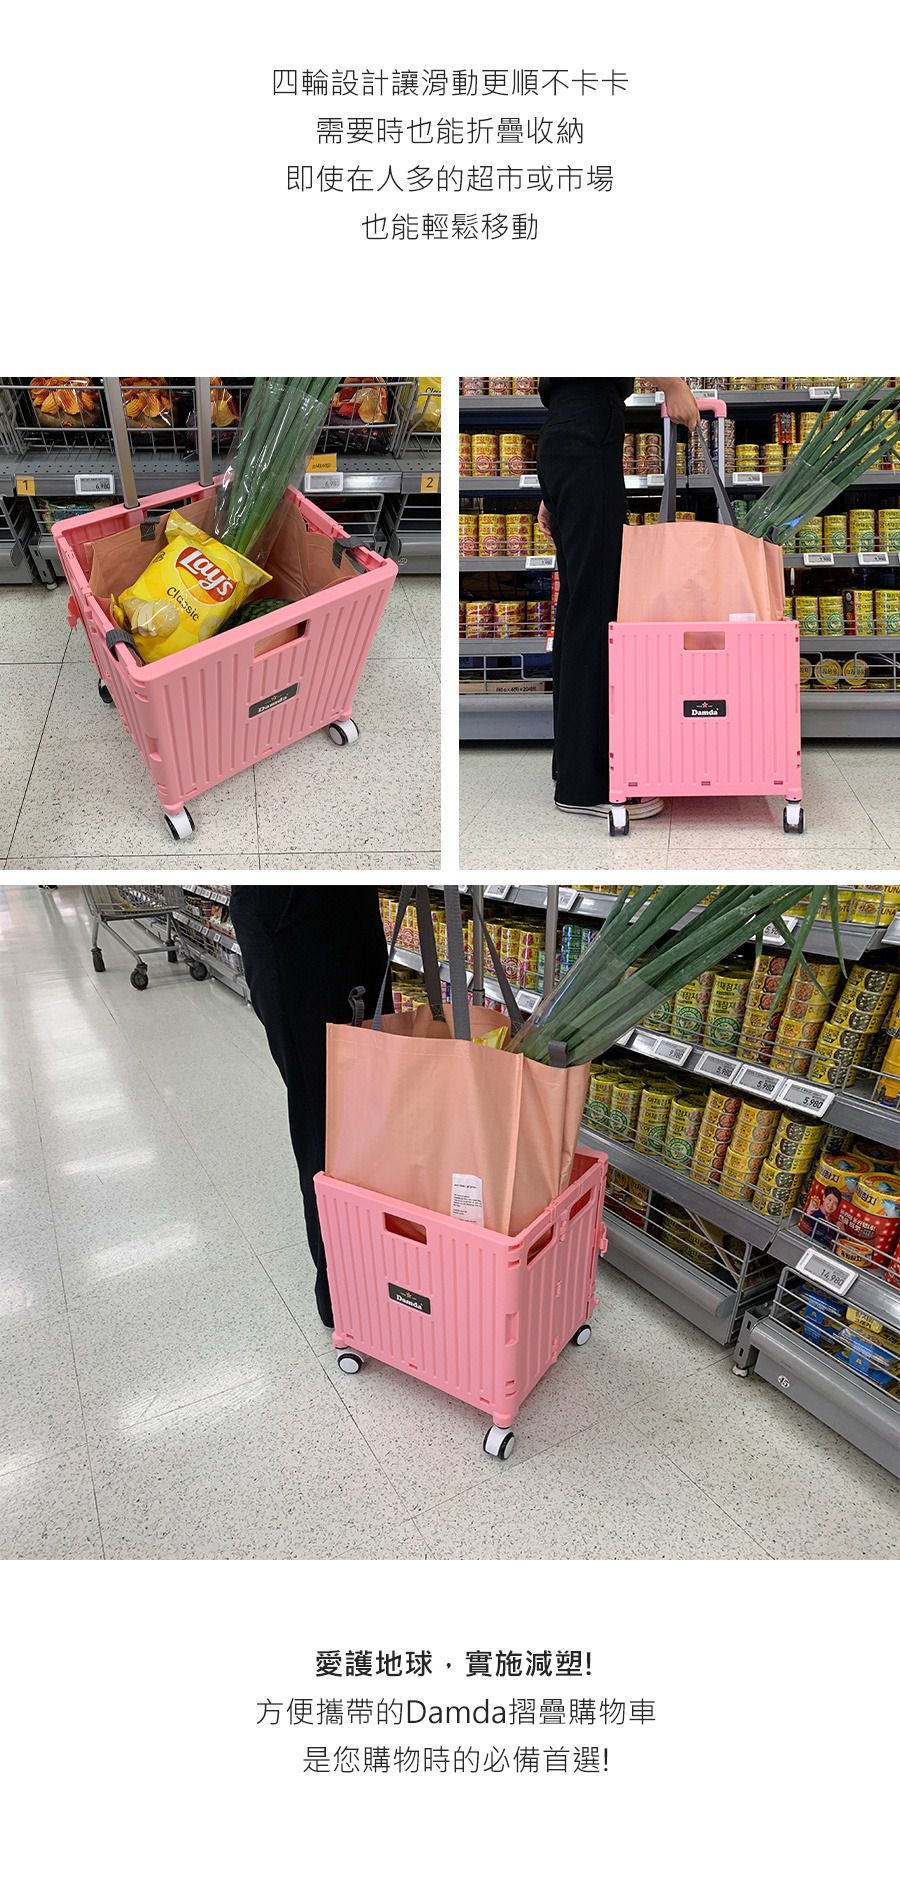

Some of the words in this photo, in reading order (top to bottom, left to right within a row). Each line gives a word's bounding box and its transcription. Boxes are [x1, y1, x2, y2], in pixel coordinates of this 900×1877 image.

[22, 480, 28, 490] 1
[426, 477, 434, 488] 2
[179, 550, 234, 596] Lay's
[166, 586, 199, 622] Classic
[691, 708, 718, 716] Damda
[802, 1096, 824, 1110] 5,980
[820, 1268, 844, 1287] 14,980
[396, 1294, 423, 1310] Damda
